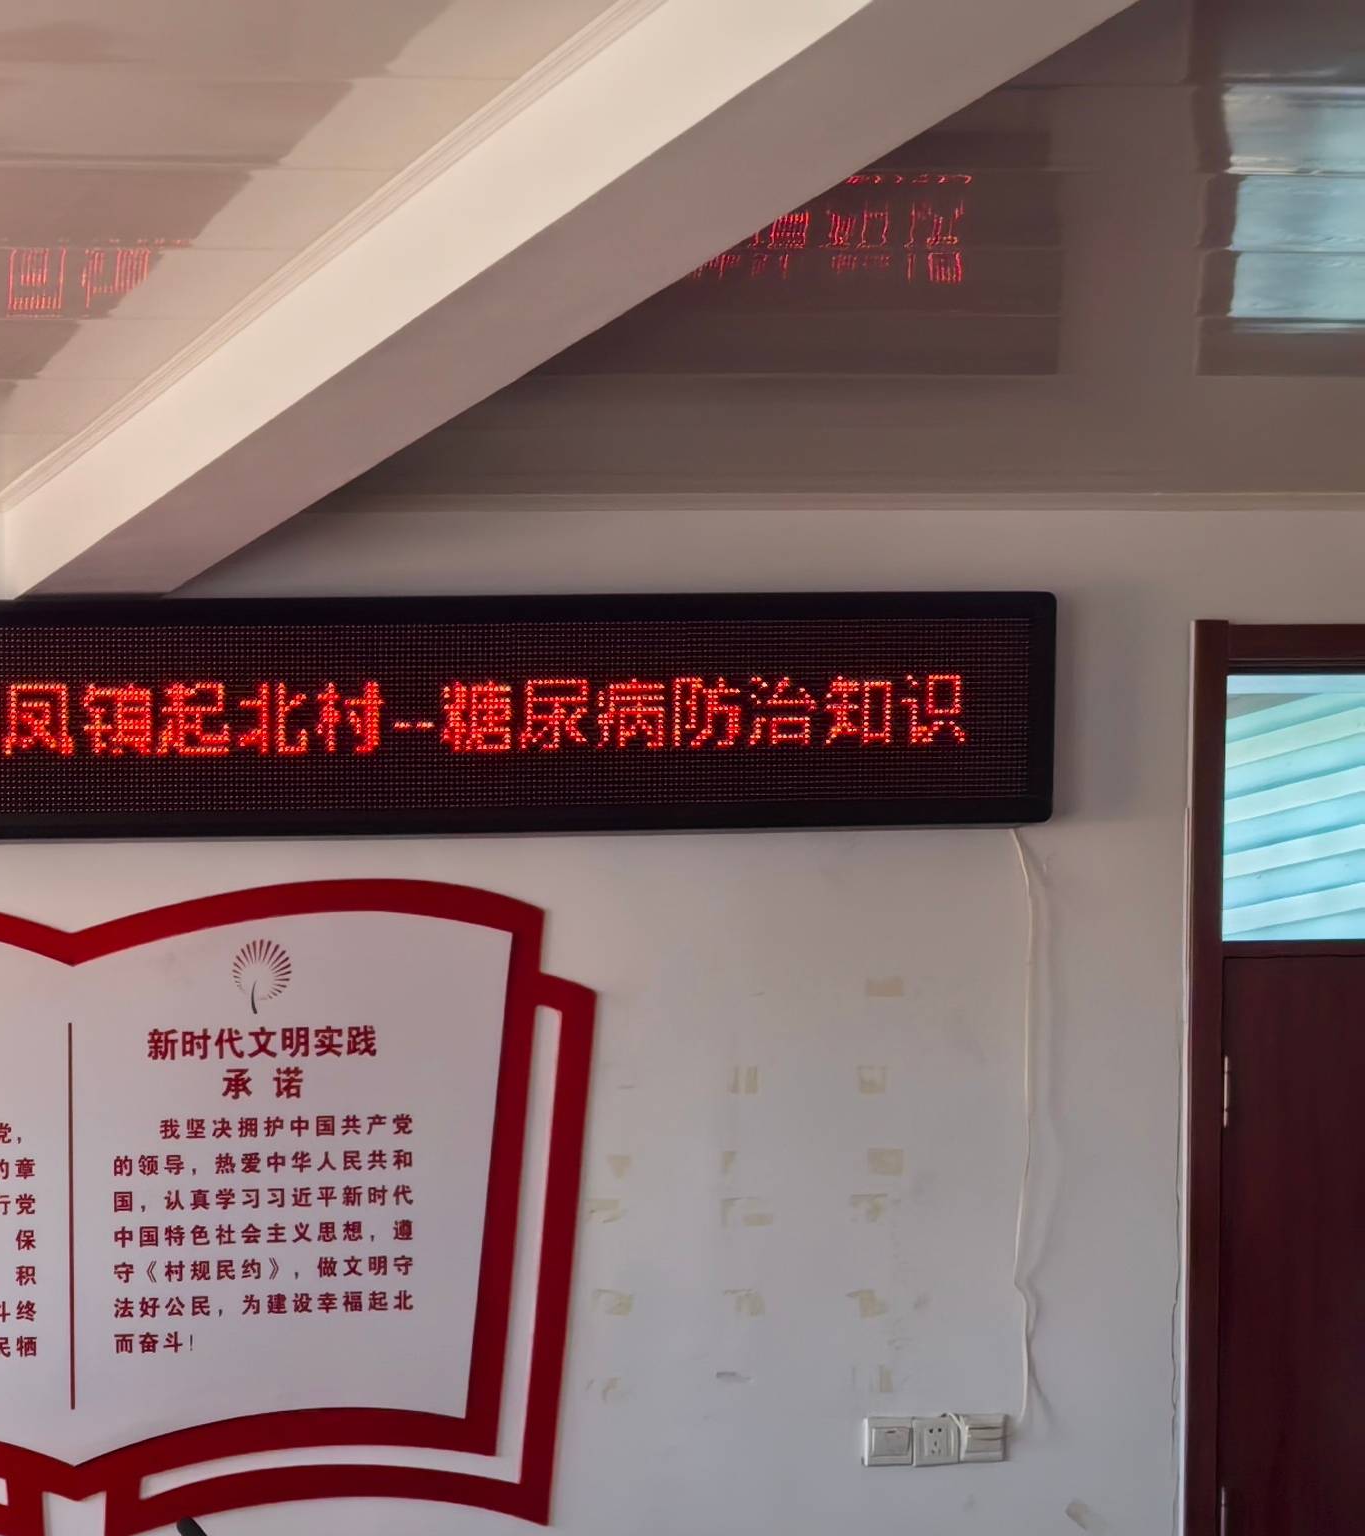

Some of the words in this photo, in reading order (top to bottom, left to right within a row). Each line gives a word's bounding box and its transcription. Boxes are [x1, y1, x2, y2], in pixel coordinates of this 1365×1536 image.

[146, 1024, 378, 1062] 新时代文明实践
[159, 1113, 414, 1141] 我坚决拥护中国共产党
[113, 1149, 414, 1177] 的领导，热爱中华人民共和
[113, 1185, 414, 1213] 国，认真学习习近平新时代
[113, 1220, 414, 1248] 中国特色社会主义思想，遵
[114, 1290, 414, 1319] 法好公民，为建设幸福起北
